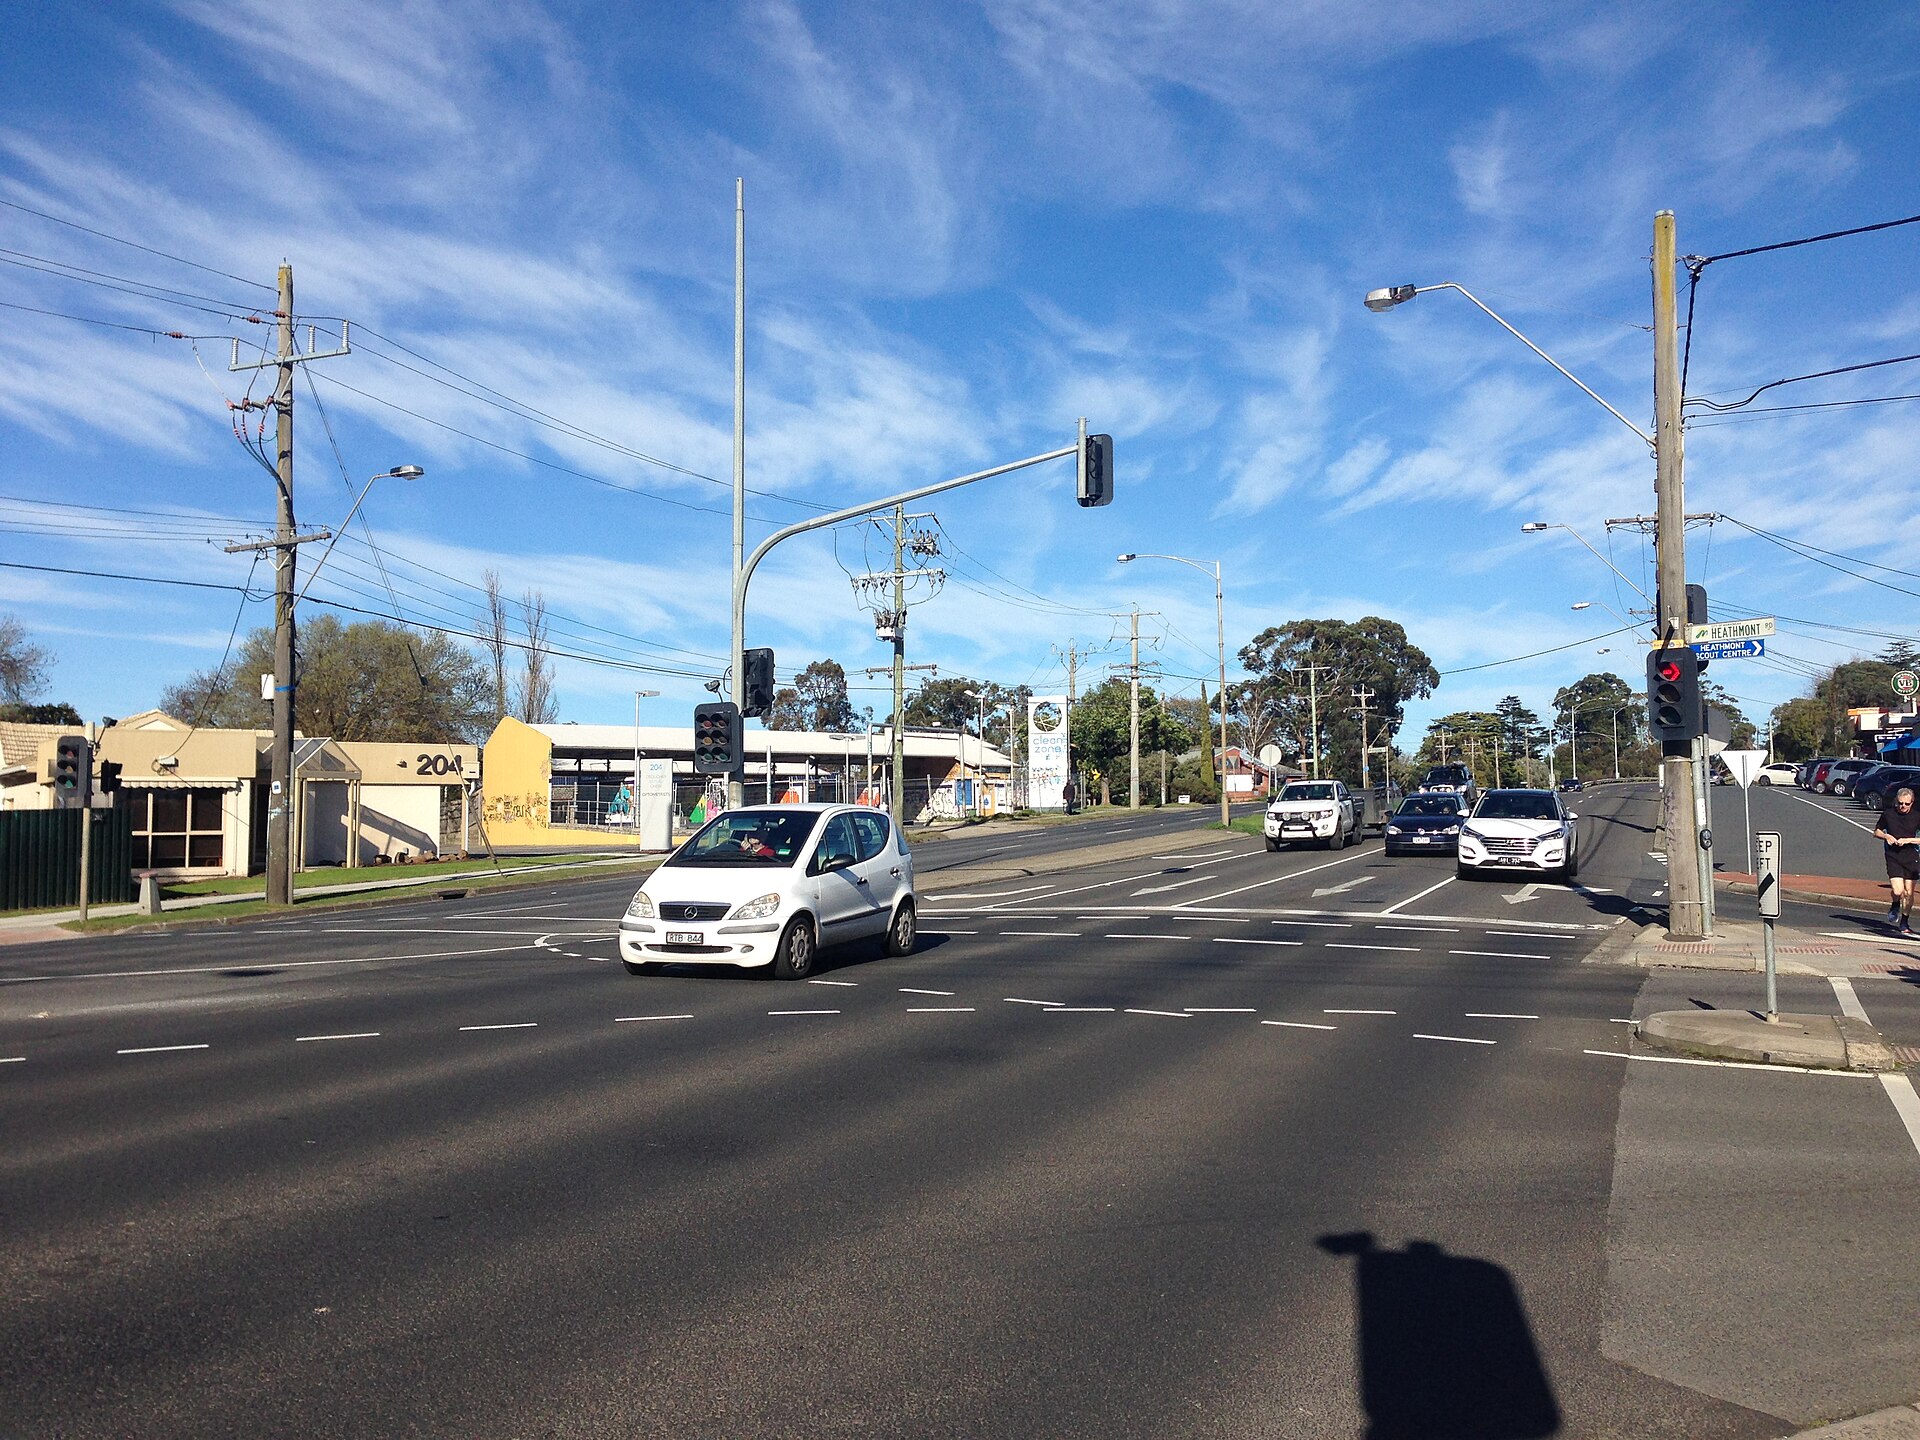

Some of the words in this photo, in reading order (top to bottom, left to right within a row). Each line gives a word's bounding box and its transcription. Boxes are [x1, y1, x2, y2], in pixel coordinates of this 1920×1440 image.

[1711, 623, 1761, 639] HEATHMONT
[1700, 641, 1746, 652] HEATHMONT
[1696, 652, 1719, 660] SCOUT
[1722, 649, 1752, 658] CENTRE
[1898, 679, 1912, 687] VB
[1032, 735, 1063, 745] clean
[416, 753, 464, 776] 204
